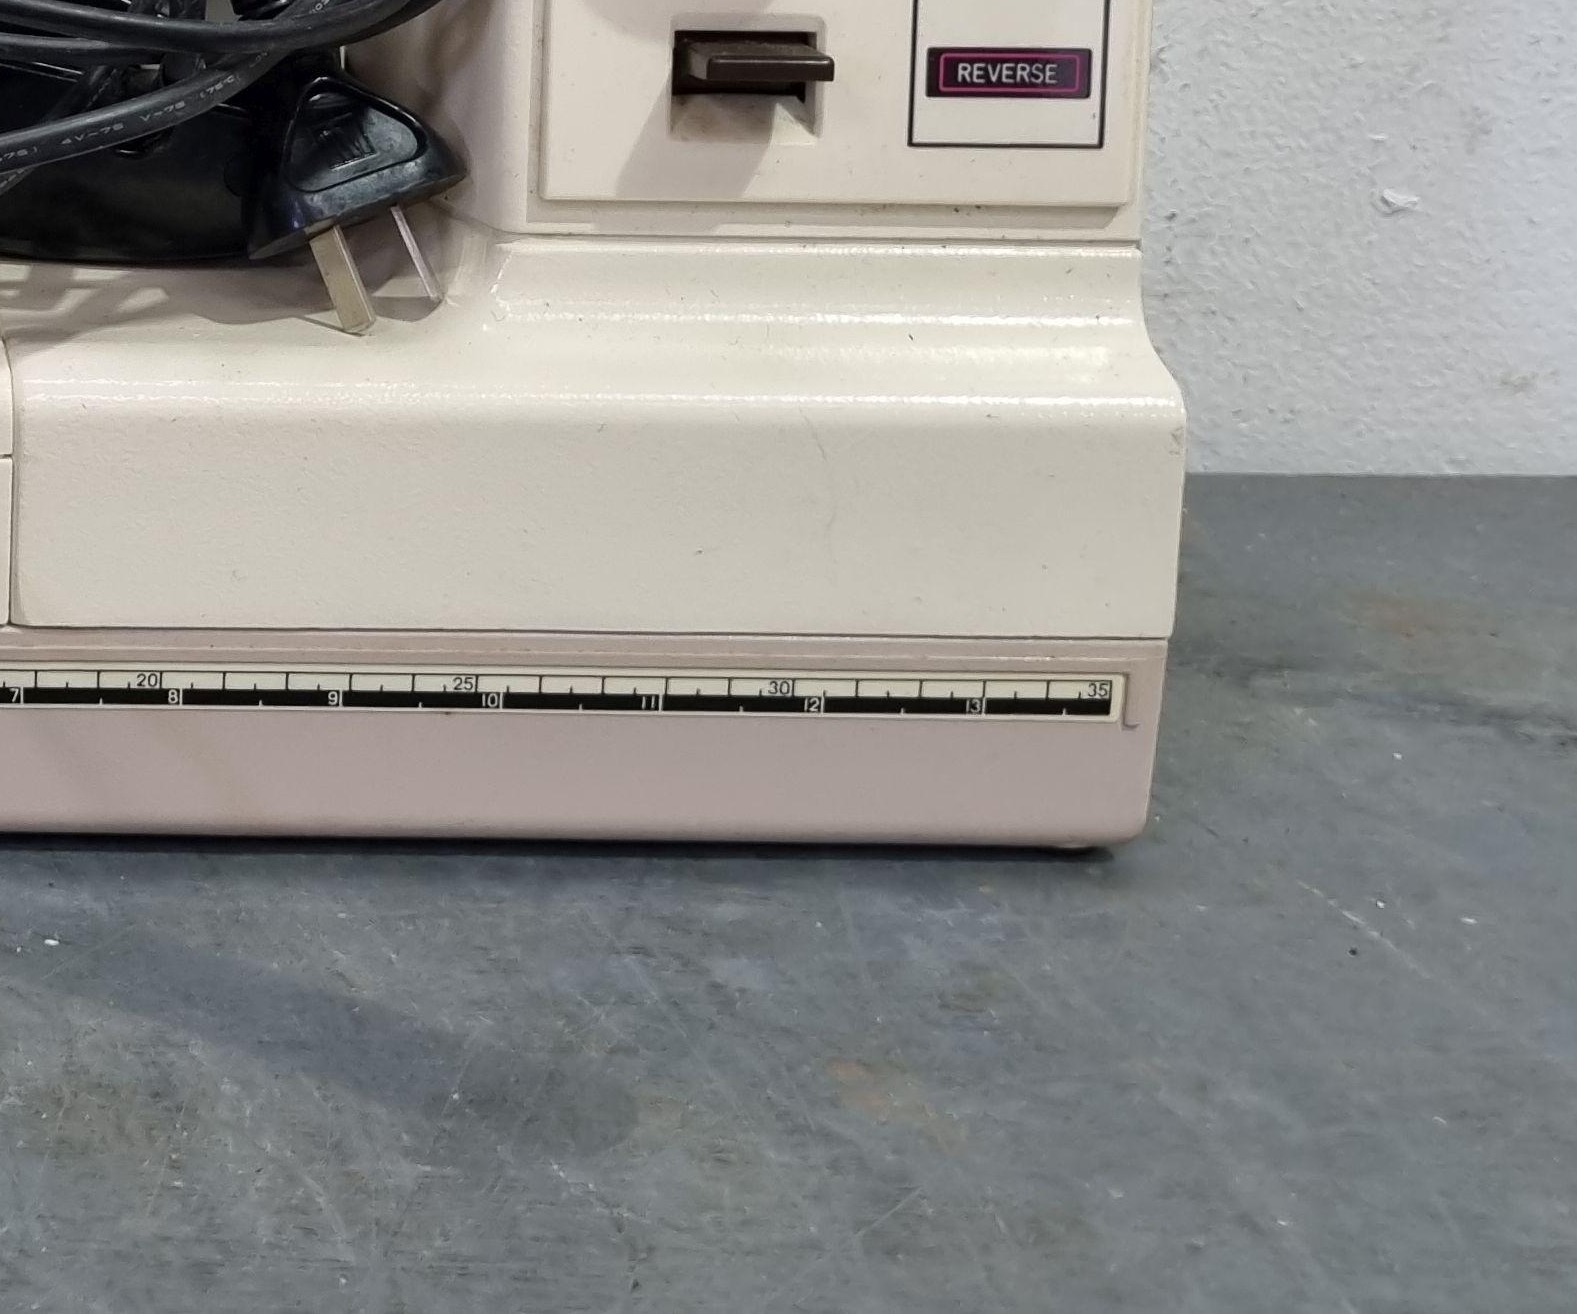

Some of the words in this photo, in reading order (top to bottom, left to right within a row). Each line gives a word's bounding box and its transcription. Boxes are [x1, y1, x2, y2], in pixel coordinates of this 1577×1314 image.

[956, 62, 1058, 85] REVERSE
[136, 673, 158, 687] 20
[453, 677, 473, 691] 25
[768, 681, 791, 696] 30
[1087, 683, 1109, 698] 35
[9, 689, 20, 703] 7
[167, 689, 179, 704] 8
[328, 691, 338, 705] 9
[481, 693, 498, 708] 10
[805, 698, 820, 712] 12
[966, 699, 981, 714] 13
